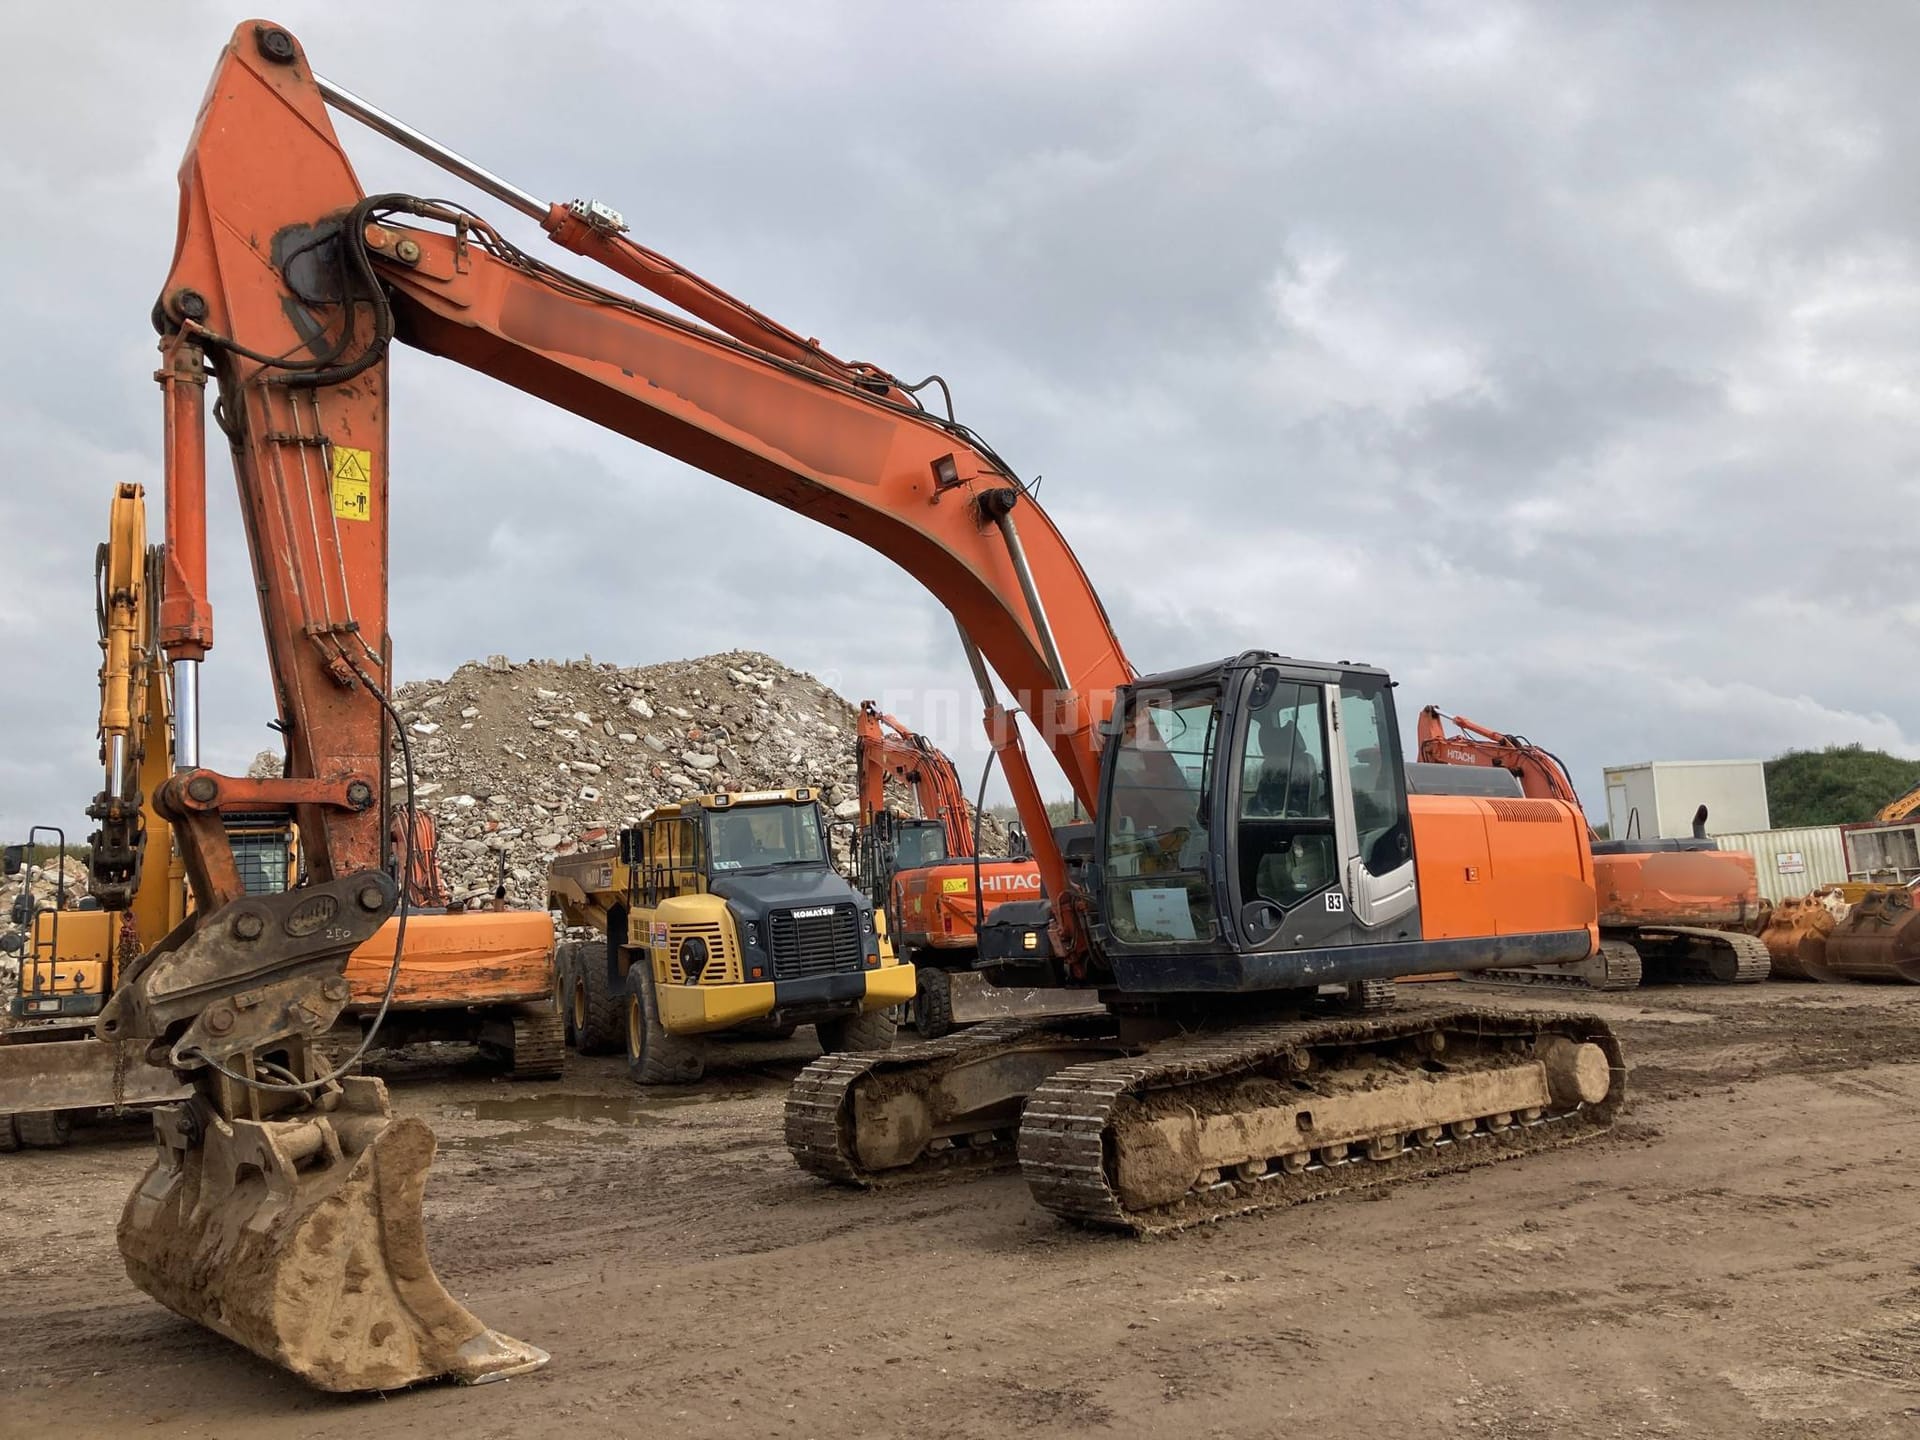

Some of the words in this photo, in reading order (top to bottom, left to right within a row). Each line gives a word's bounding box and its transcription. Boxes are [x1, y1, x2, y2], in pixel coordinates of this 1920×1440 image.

[1447, 749, 1476, 763] HITACHI
[980, 873, 1041, 891] HITAC
[1327, 894, 1342, 910] 83
[793, 907, 834, 919] KOMATSU
